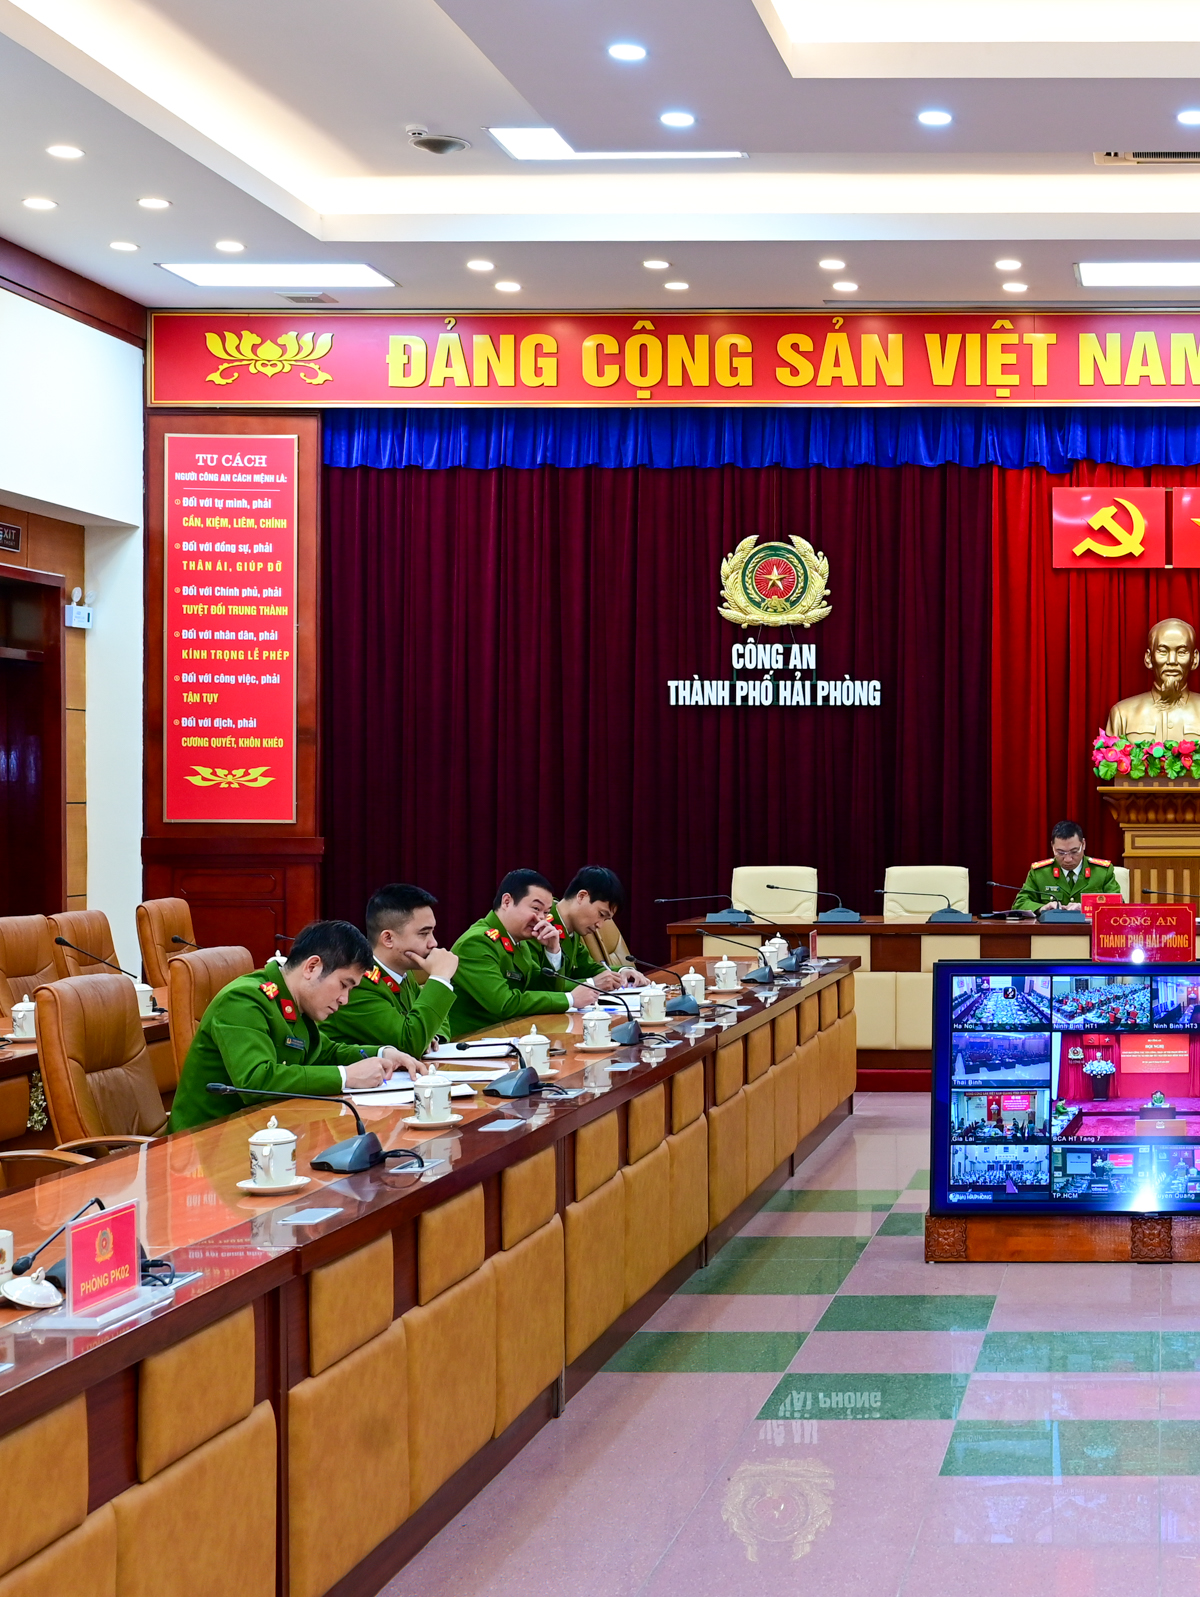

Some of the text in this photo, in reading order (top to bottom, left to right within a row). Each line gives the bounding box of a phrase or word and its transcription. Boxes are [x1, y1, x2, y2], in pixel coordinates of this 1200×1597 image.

[386, 317, 559, 388] ĐẢNG
[581, 320, 754, 399] CỘNG
[775, 316, 905, 387] SẢN
[925, 319, 1058, 398] VIỆT
[222, 452, 267, 466] CÁCH
[199, 472, 218, 481] CÔNG
[232, 473, 252, 482] CÁCH
[254, 473, 274, 484] MỆNH
[276, 474, 287, 482] LÀ:
[182, 496, 271, 509] Đối với tự mình, phải
[183, 514, 286, 529] CẦN, KIỆM, LIÊM, CHÍNH
[183, 560, 282, 572] THÂN ÁI, GIÚP ĐỠ
[182, 603, 288, 616] TUYỆT ĐỐI TRUNG THÀNH
[182, 648, 289, 661] KÍNH TRỌNG LỄ PHÉP
[732, 638, 816, 671] CÔNG AN
[668, 671, 880, 706] THÀNH PHỐ HẢI PHÒNG
[183, 692, 218, 704] TẬN TỤY
[182, 736, 283, 748] CƯƠNG QUYẾT, KHÔN KHÉO
[1111, 915, 1177, 925] CÔNG AN
[1100, 932, 1125, 947] THÀNH
[1128, 930, 1144, 947] PHỐ
[80, 1264, 130, 1296] PHÒNG PK02
